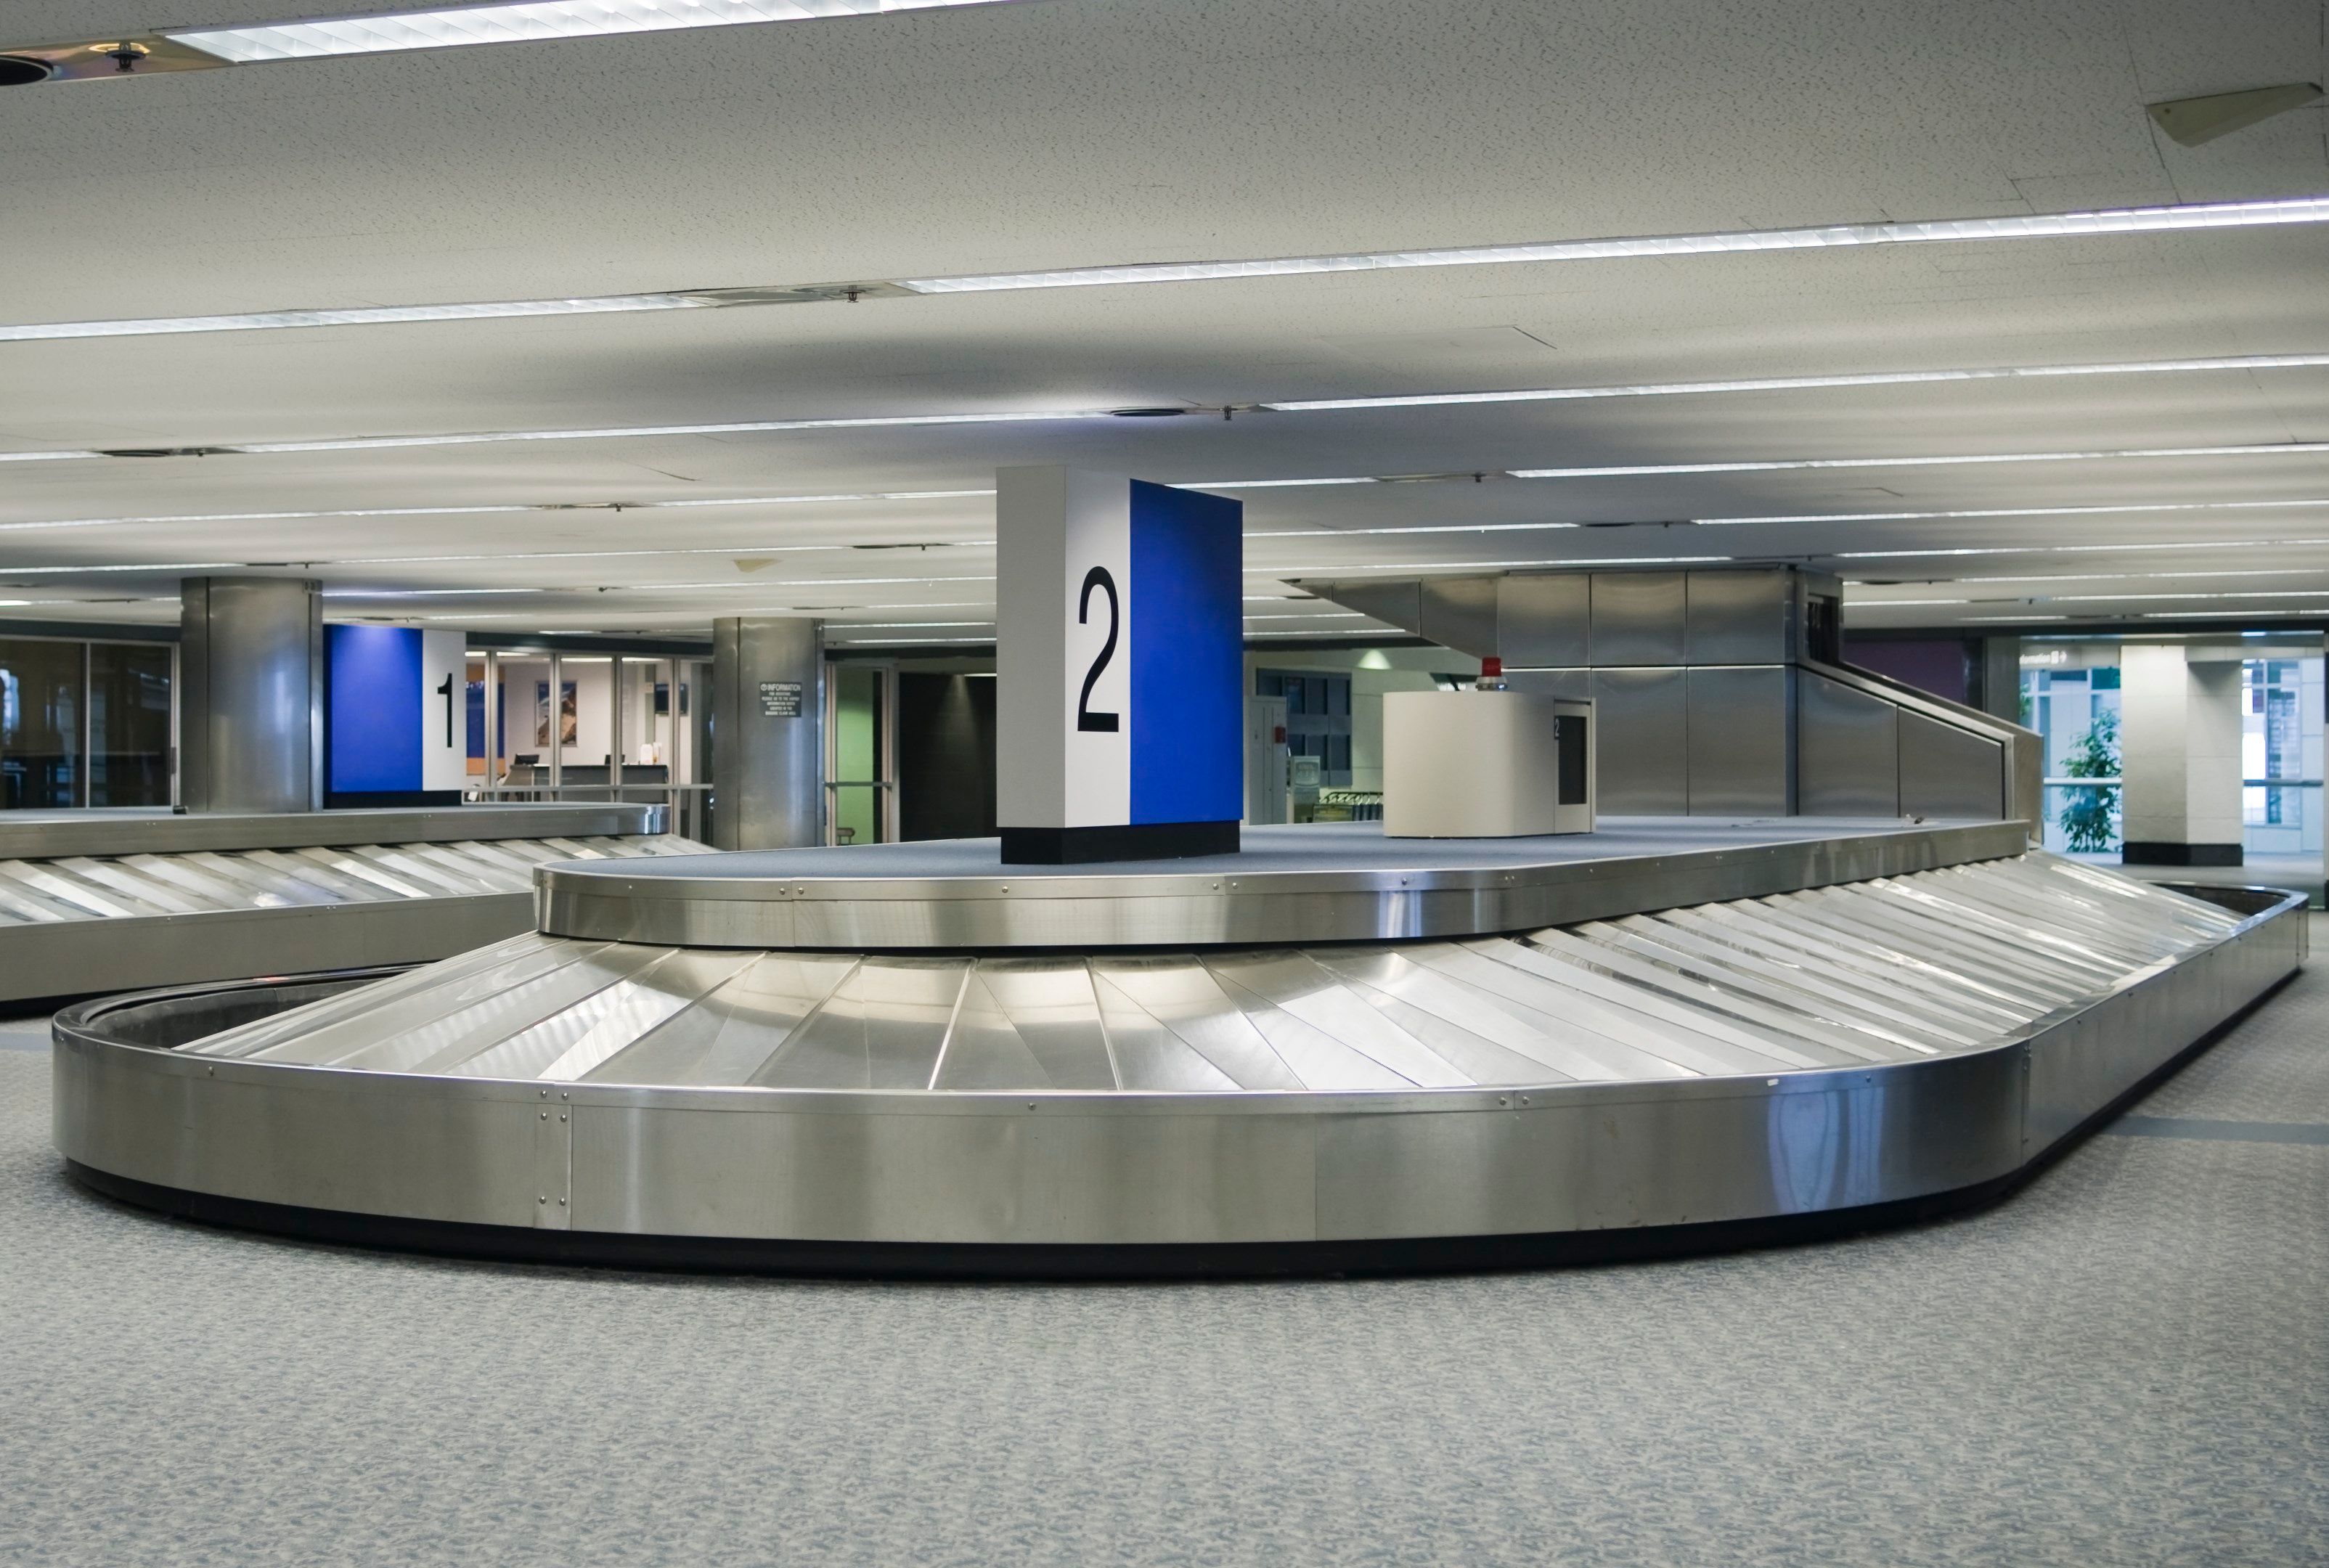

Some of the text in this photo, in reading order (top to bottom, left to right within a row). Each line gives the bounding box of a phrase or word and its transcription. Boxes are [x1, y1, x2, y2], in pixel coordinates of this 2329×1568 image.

[1078, 566, 1119, 732] 2
[437, 673, 452, 748] 1
[1554, 718, 1559, 737] 2
